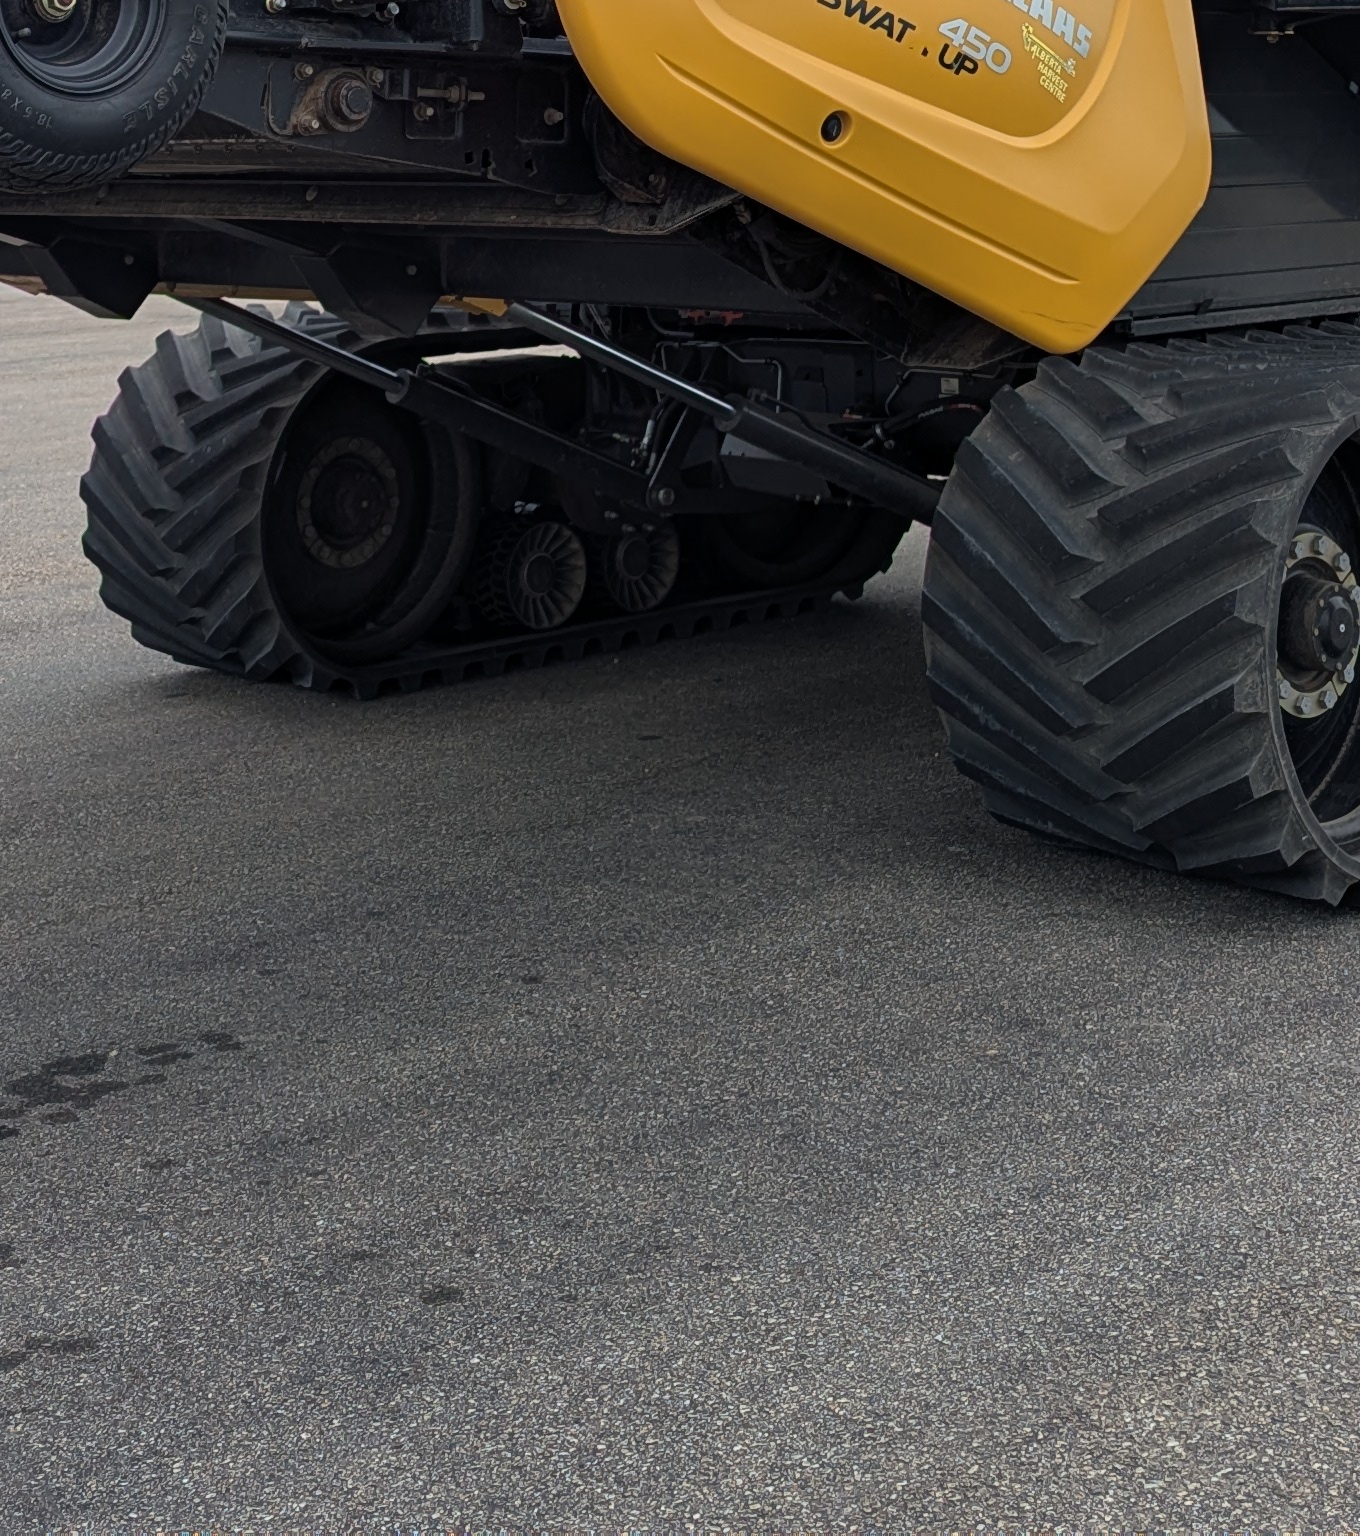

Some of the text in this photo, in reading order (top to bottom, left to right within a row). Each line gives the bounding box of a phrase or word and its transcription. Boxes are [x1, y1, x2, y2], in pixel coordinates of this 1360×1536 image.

[938, 18, 1012, 74] 450
[938, 42, 979, 76] UP
[1030, 44, 1062, 75] ALBERTA
[122, 5, 209, 134] CARLISLE
[1037, 61, 1068, 92] HARVEST
[1039, 76, 1066, 103] CENTRE
